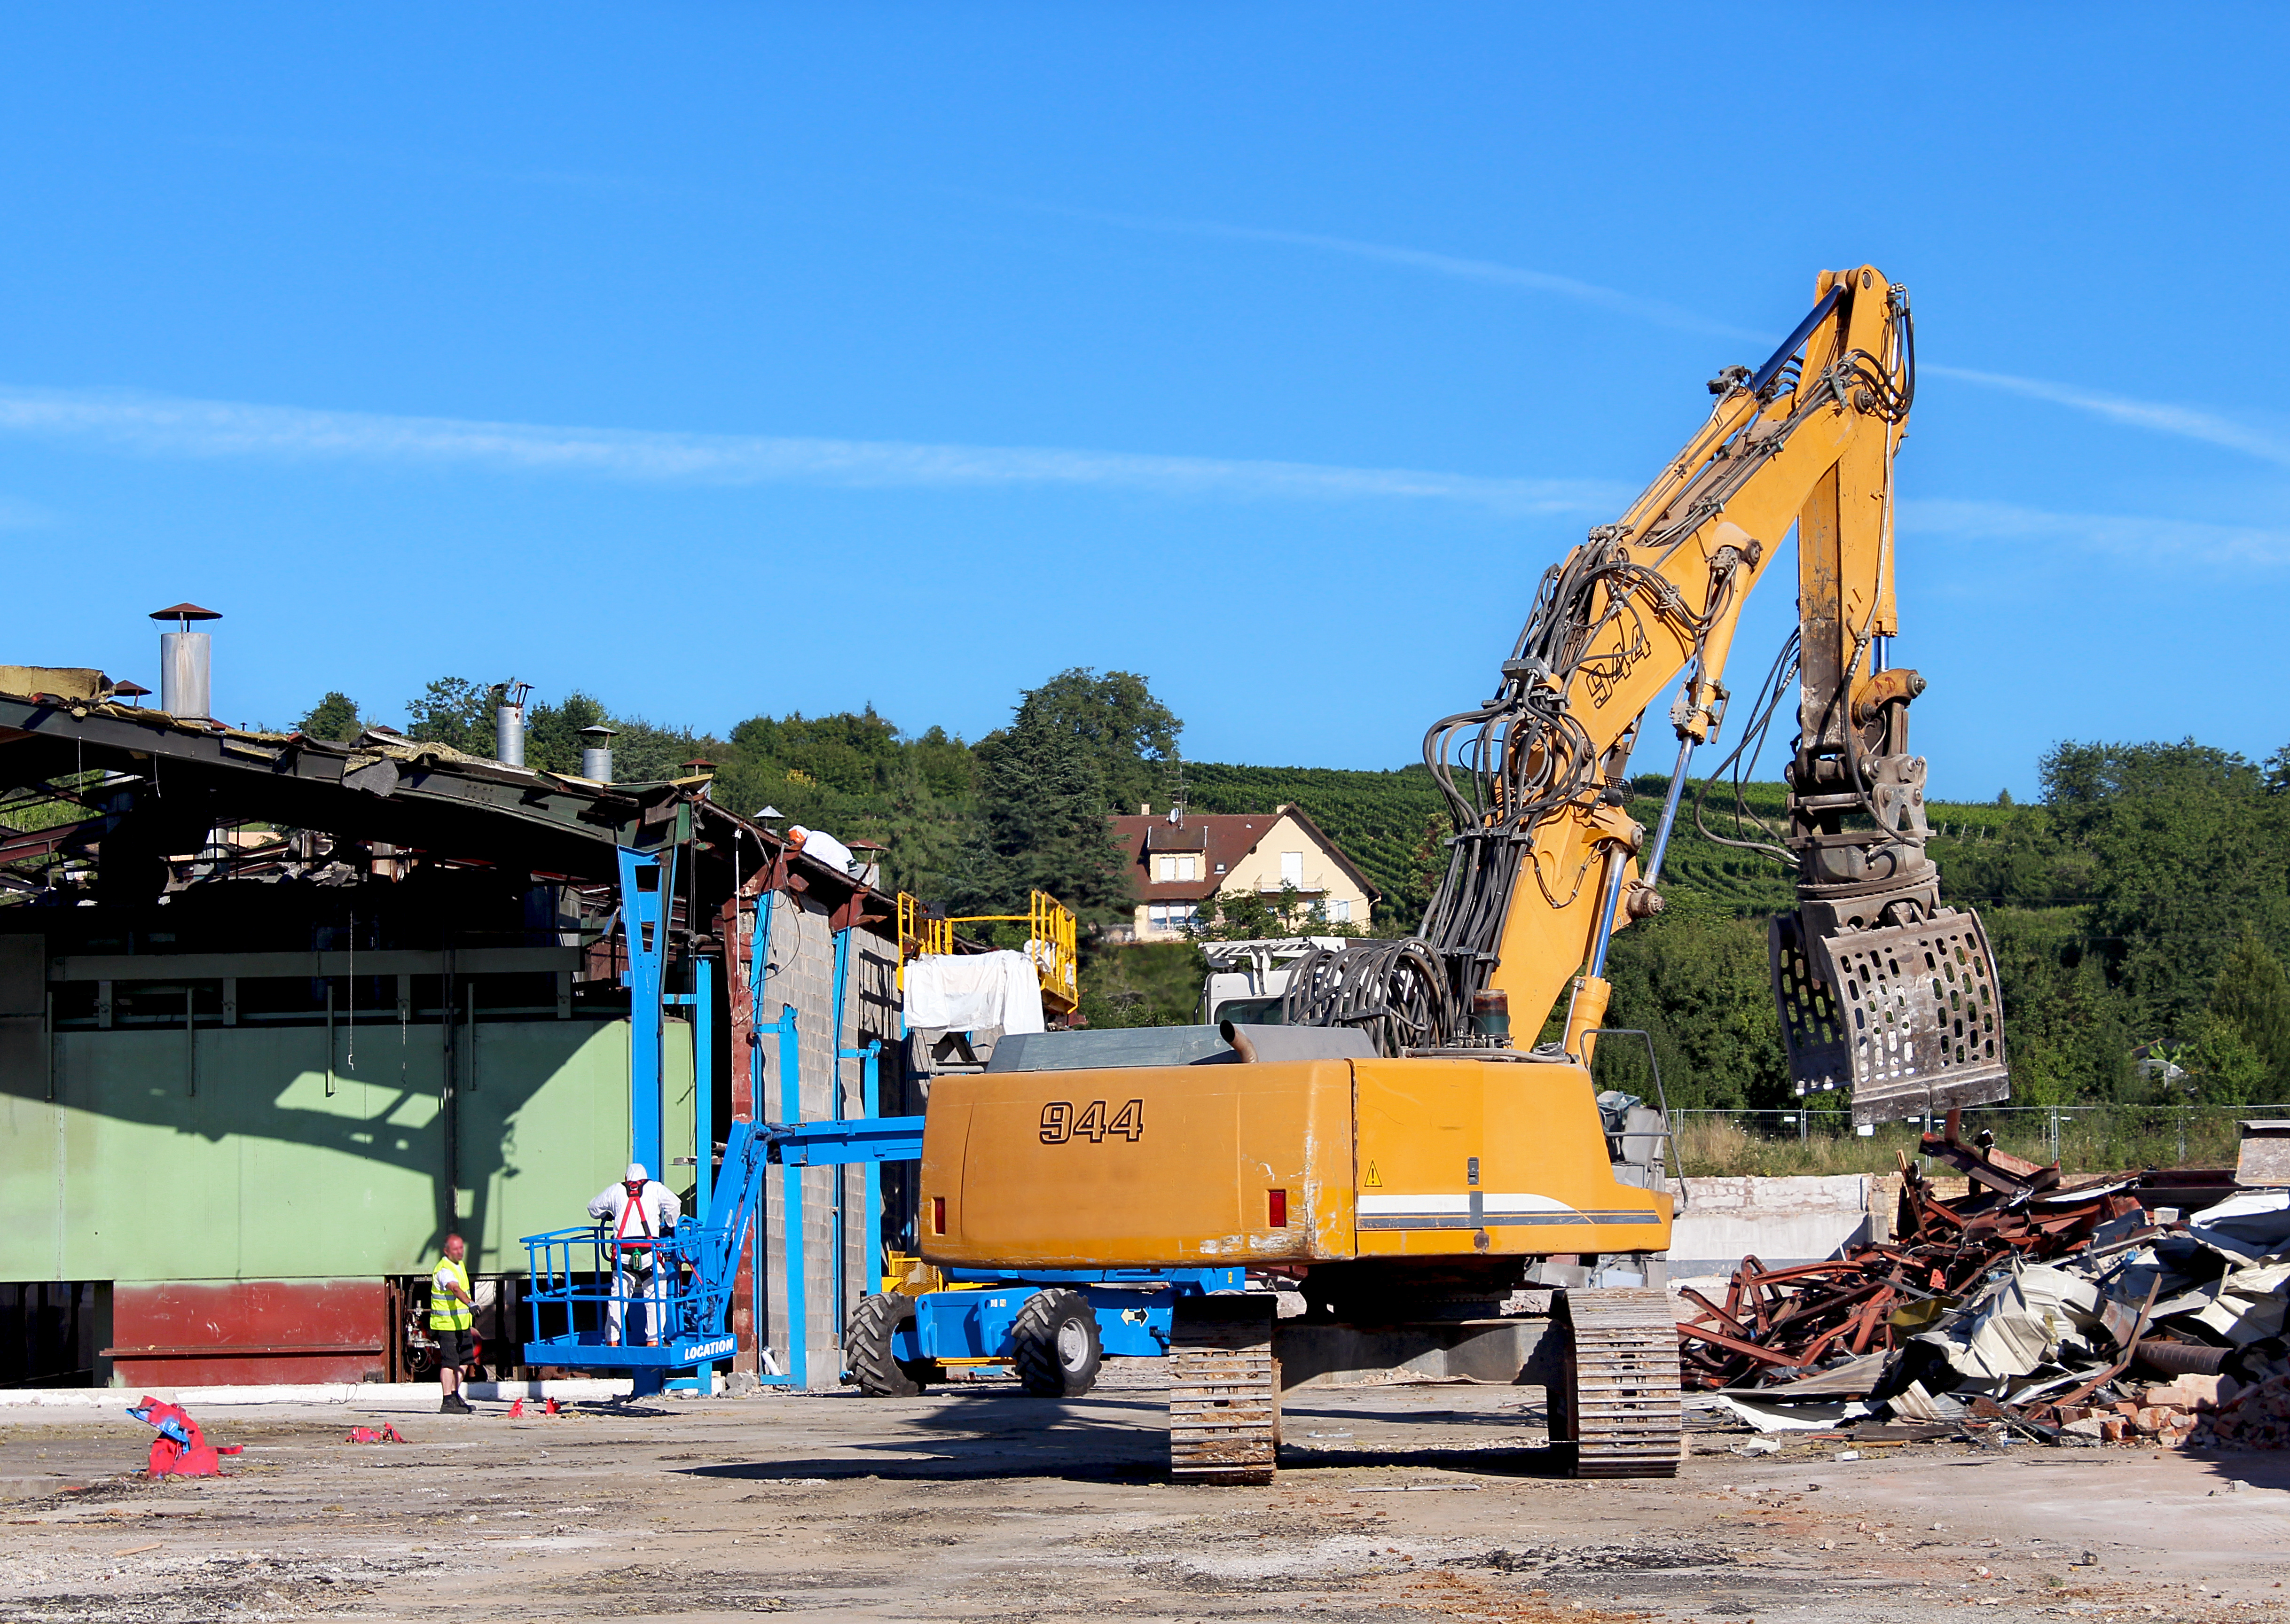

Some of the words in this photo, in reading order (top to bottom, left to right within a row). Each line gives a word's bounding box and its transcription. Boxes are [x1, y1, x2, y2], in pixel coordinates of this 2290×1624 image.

[1586, 623, 1652, 709] 944
[1039, 1099, 1144, 1145] 944
[684, 1337, 734, 1360] LOCATION
